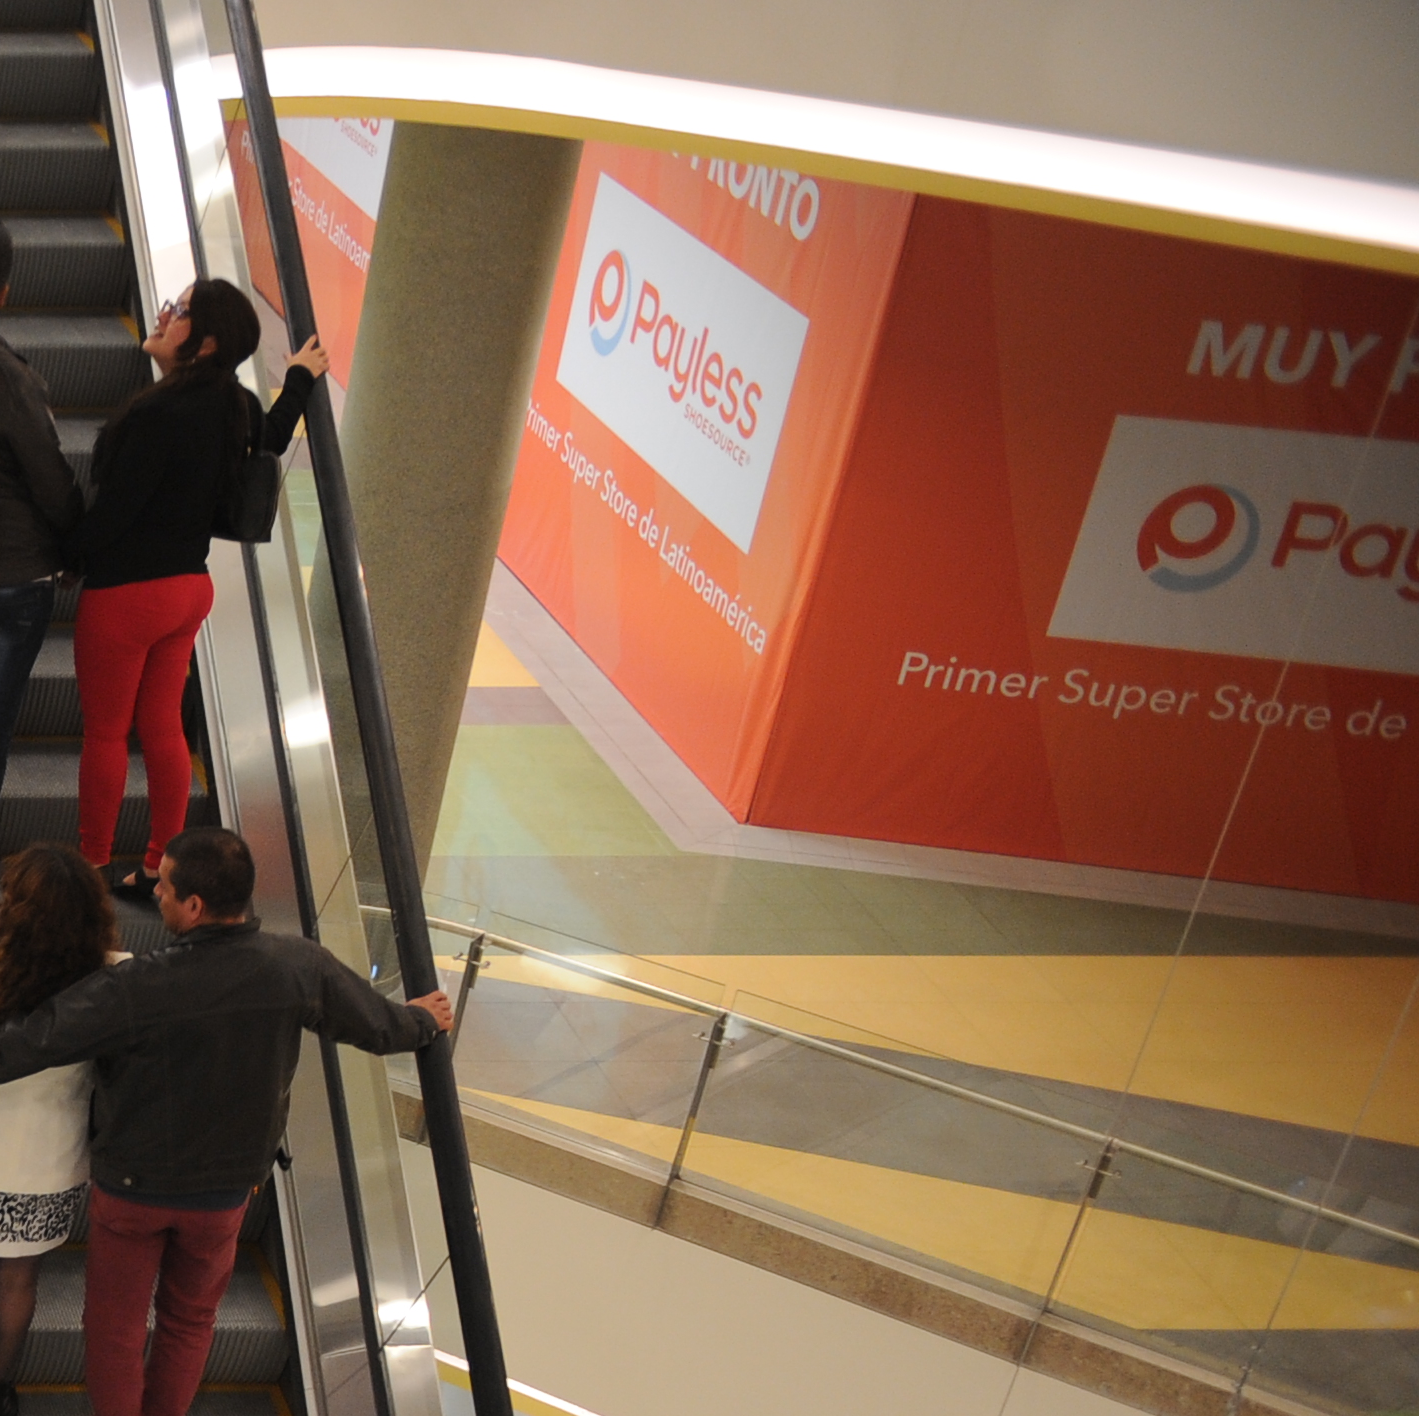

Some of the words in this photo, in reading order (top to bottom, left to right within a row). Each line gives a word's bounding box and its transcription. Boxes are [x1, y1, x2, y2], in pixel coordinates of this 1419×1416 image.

[315, 201, 328, 233] de
[629, 278, 763, 440] Payless
[1186, 319, 1382, 388] MUY
[526, 397, 562, 452] rimer
[560, 431, 602, 484] Super
[600, 469, 639, 528] Store
[638, 508, 659, 548] de
[659, 526, 767, 656] Latinoamérica
[897, 651, 1049, 698] Primer
[1058, 668, 1199, 720] Super
[1208, 684, 1332, 732] Store
[1346, 700, 1408, 740] de
